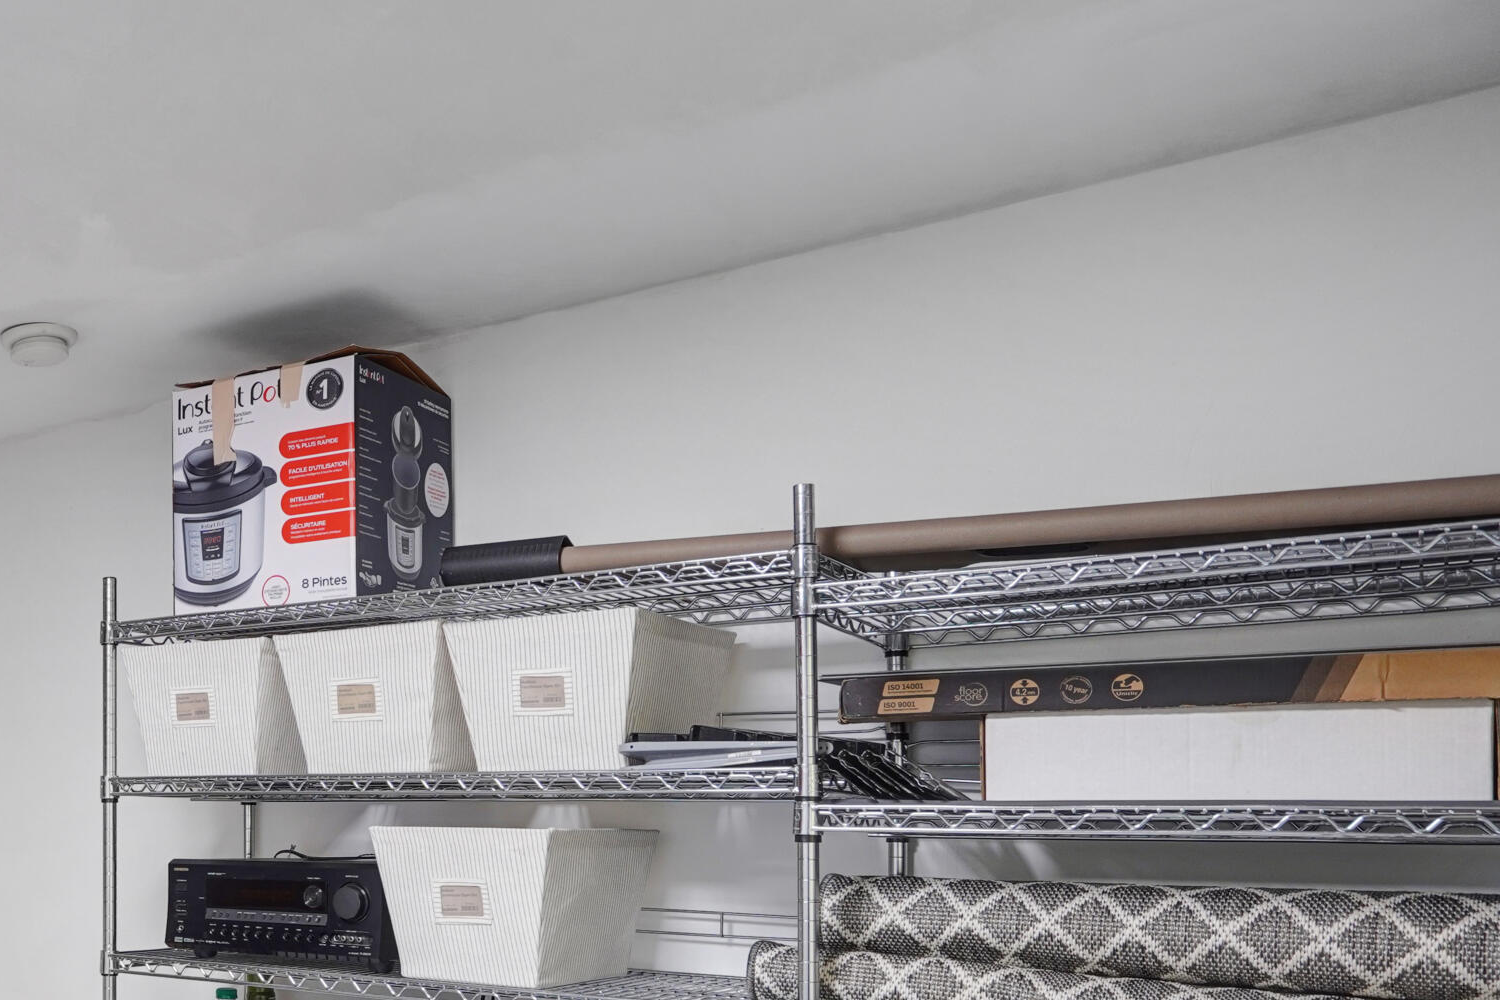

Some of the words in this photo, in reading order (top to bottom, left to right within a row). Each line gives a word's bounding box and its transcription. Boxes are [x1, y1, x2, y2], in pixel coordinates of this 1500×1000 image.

[178, 386, 245, 420] Instt
[178, 426, 193, 436] Lux
[317, 437, 339, 446] RAPIDE
[288, 466, 308, 475] FACILE
[308, 460, 348, 472] D'UTILISATION
[290, 492, 324, 503] INTELLIGENT
[290, 520, 326, 530] SÉCURITAIRE
[302, 578, 310, 588] 8
[312, 576, 348, 588] Pintes
[902, 682, 924, 690] 14001
[959, 686, 983, 695] floor
[1073, 686, 1088, 694] year
[1015, 688, 1027, 696] 4.2
